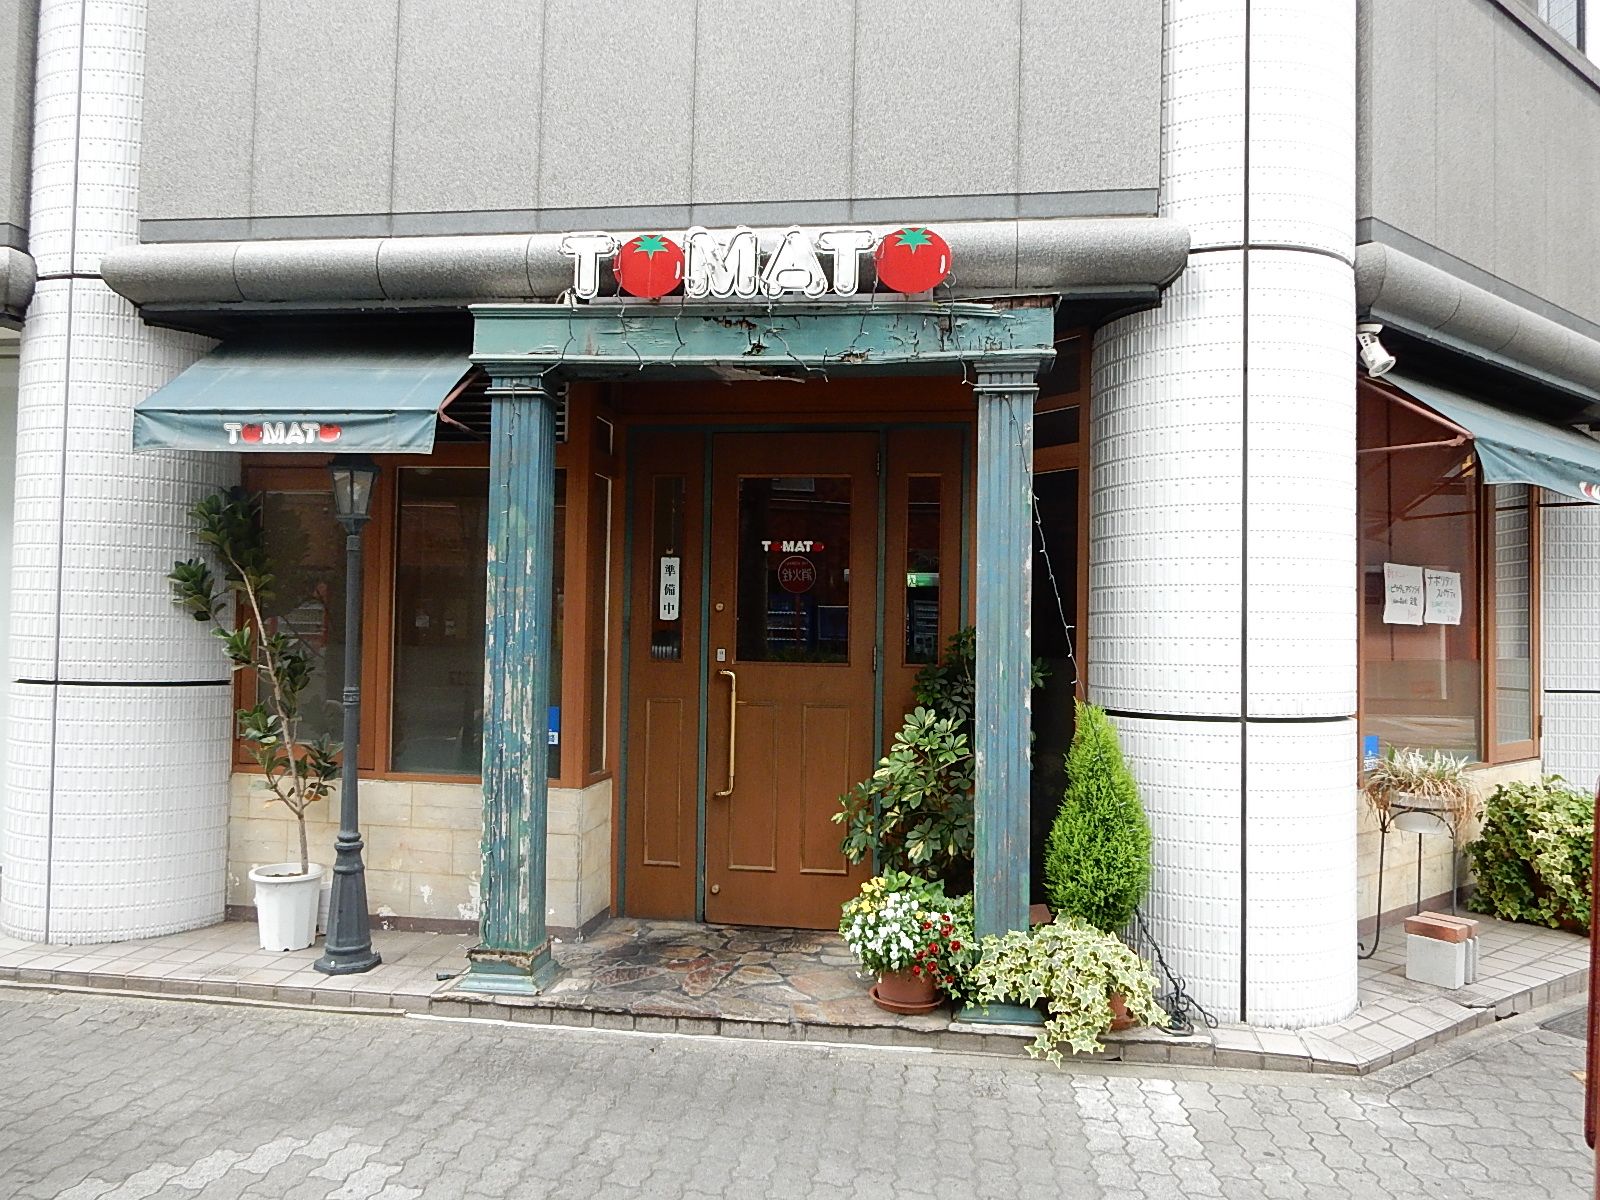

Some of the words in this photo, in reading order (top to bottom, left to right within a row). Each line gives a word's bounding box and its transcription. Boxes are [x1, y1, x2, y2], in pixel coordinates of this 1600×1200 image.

[561, 225, 952, 298] TOMATO
[223, 421, 342, 445] TOMATO
[663, 563, 676, 615] 準備中
